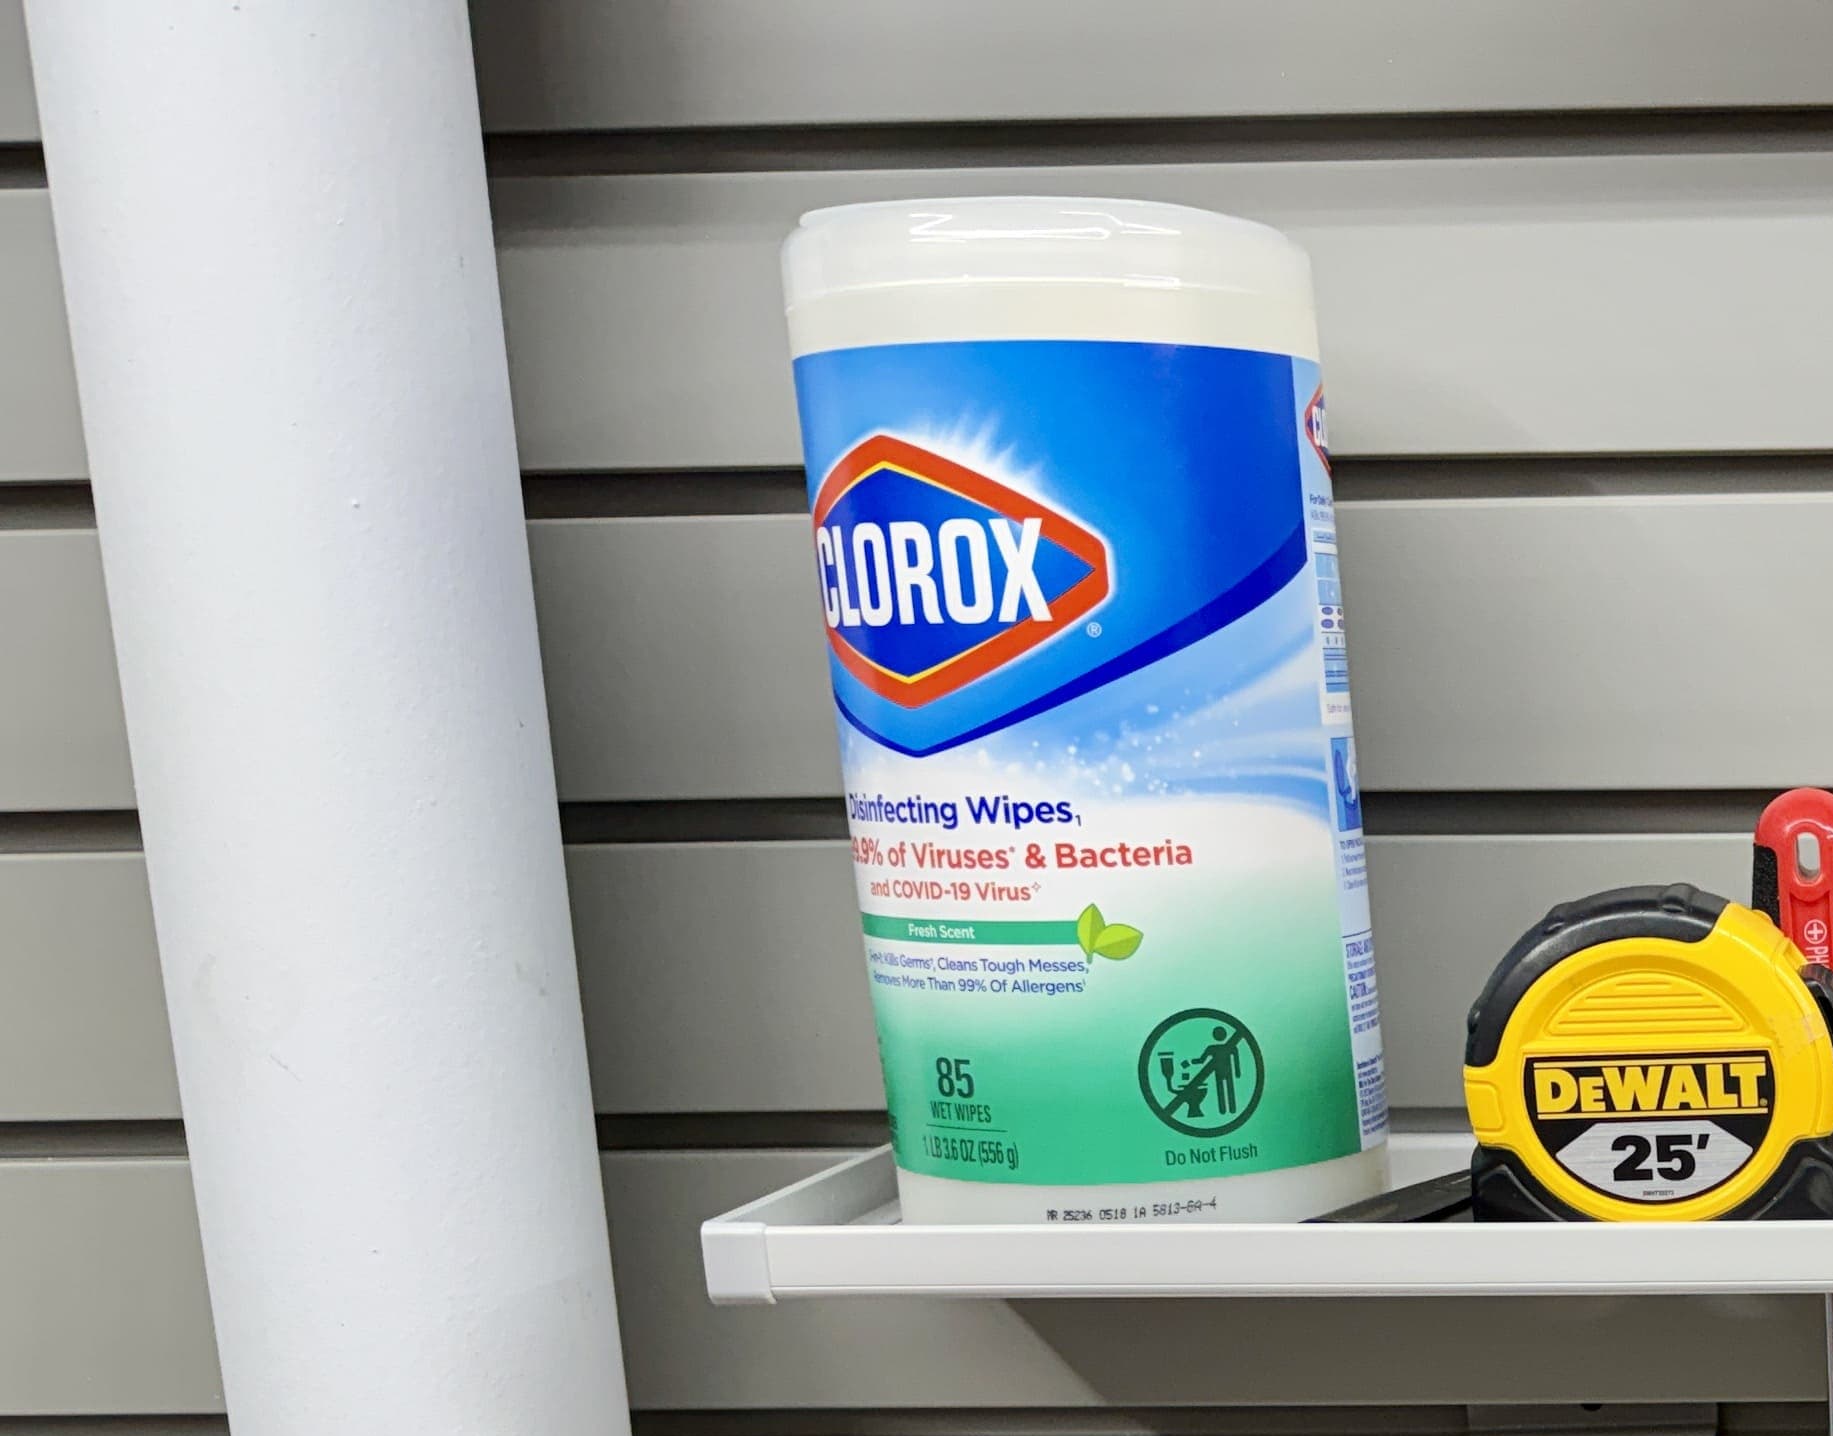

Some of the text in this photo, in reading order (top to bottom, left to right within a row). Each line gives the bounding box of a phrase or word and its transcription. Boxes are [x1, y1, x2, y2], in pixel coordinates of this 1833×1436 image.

[817, 518, 1053, 628] CLOROX
[849, 793, 958, 829] Disinfecting
[850, 836, 883, 866] 9.9%
[888, 841, 907, 867] of
[1025, 843, 1047, 869] &
[1055, 838, 1193, 868] Bacteria
[870, 879, 1032, 901] and COVID-19 Virus
[908, 923, 975, 939] Fresh Scent
[938, 957, 978, 972] Cleans
[980, 958, 1025, 975] Tough
[1029, 959, 1089, 974] Messes,
[902, 974, 925, 989] More
[927, 976, 956, 991] Than
[958, 979, 987, 993] 99%
[990, 979, 1007, 993] Of
[936, 1057, 975, 1098] 85
[930, 1101, 992, 1123] WET WIPES
[930, 1136, 942, 1158] LB
[961, 1139, 976, 1162] OZ
[978, 1140, 1004, 1166] (556
[1007, 1142, 1019, 1170] g)
[1165, 1144, 1258, 1166] Do Not Flush
[1611, 1134, 1710, 1181] 25'
